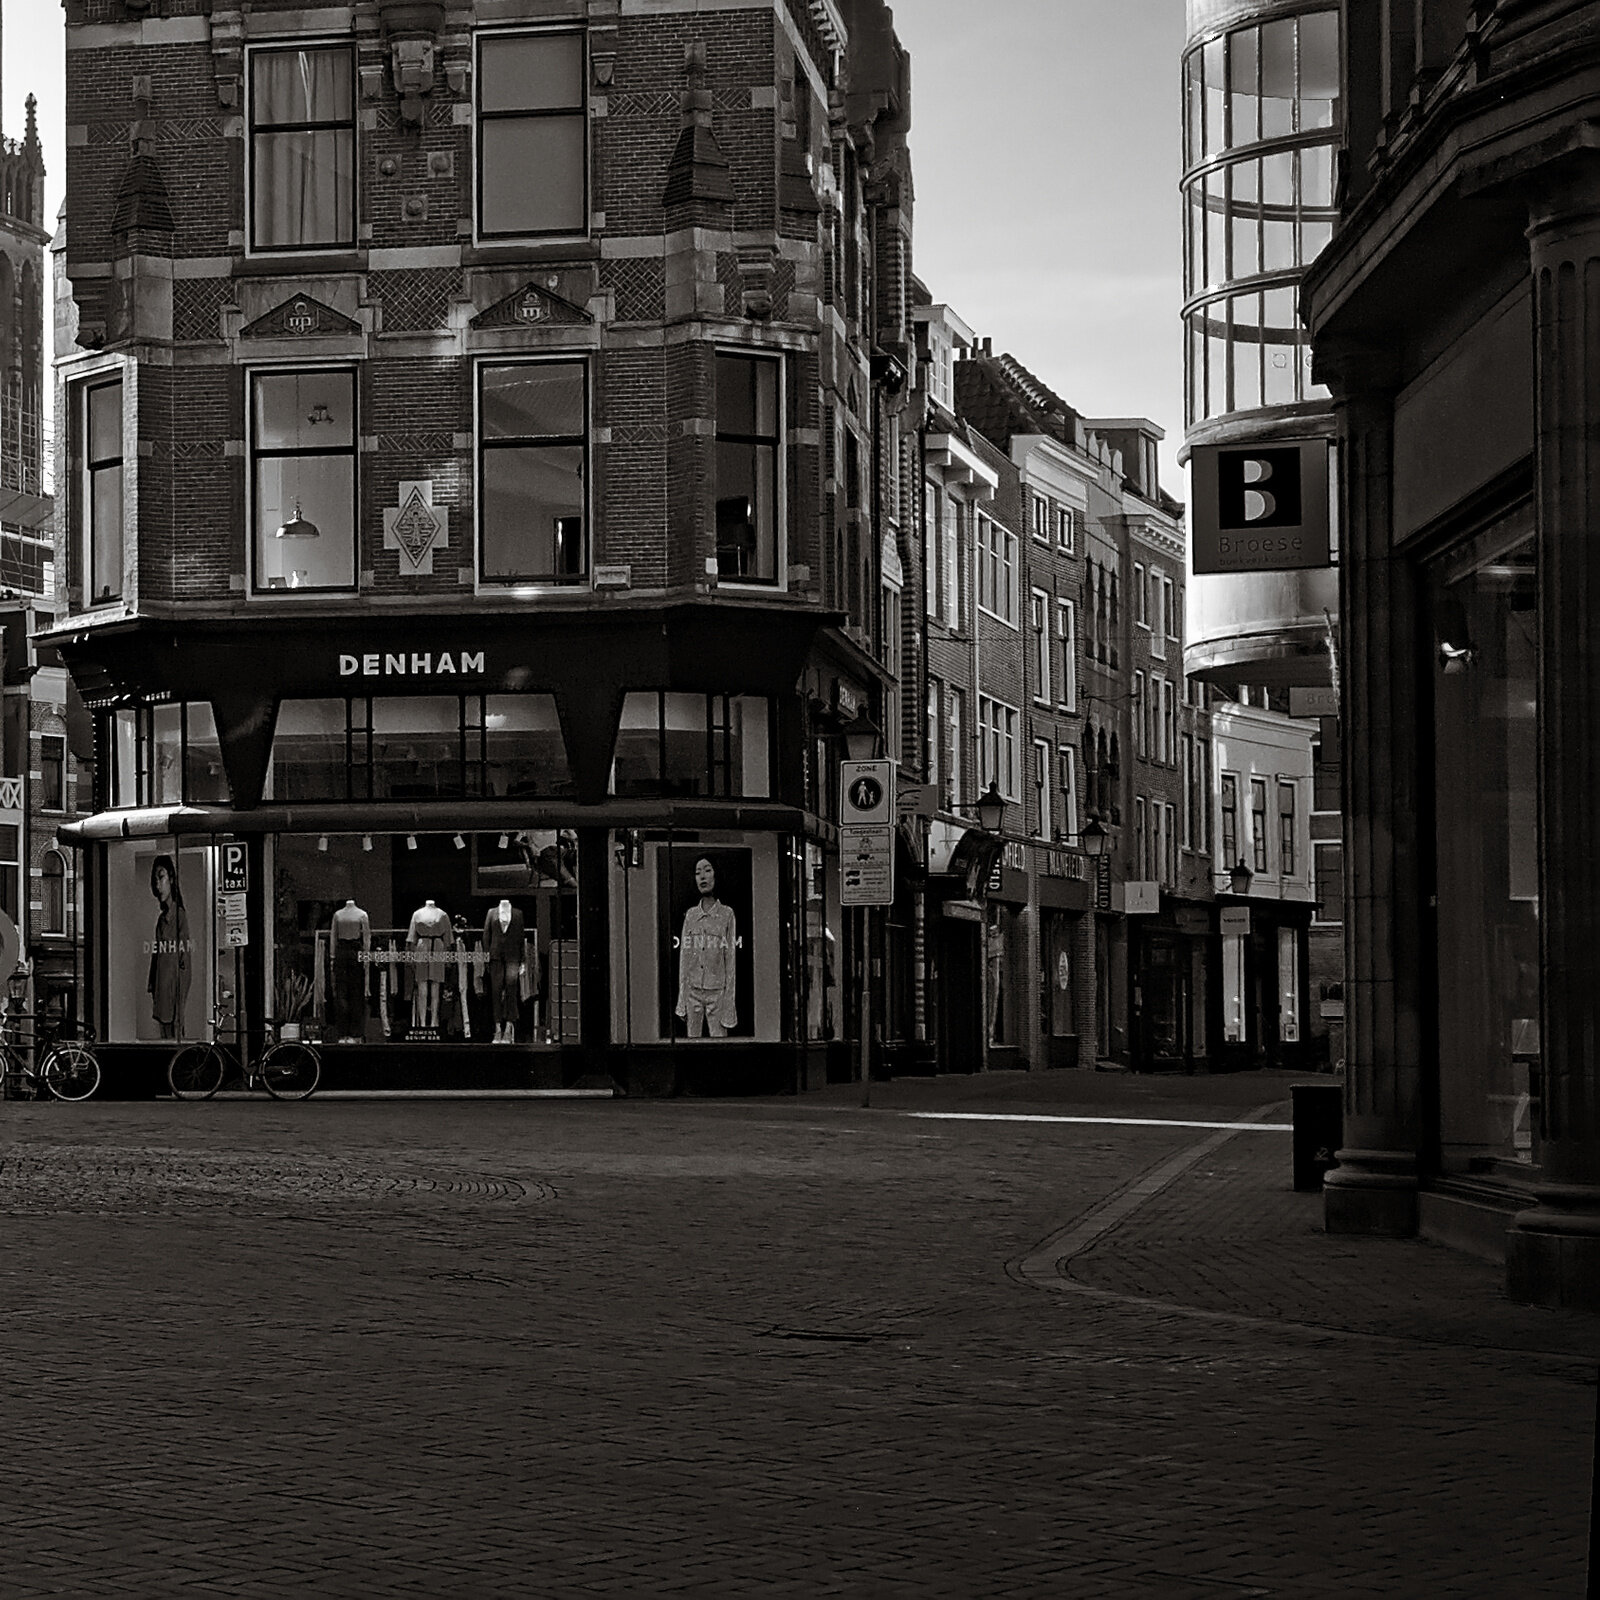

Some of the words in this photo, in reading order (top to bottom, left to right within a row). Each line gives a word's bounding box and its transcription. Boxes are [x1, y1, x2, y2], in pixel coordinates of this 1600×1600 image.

[1219, 537, 1302, 553] Broese
[339, 651, 485, 676] DENHAM
[1307, 693, 1335, 705] Bro
[226, 846, 243, 873] P
[225, 877, 246, 889] taxi
[143, 939, 196, 954] DENHAM
[672, 935, 743, 949] DENHAM
